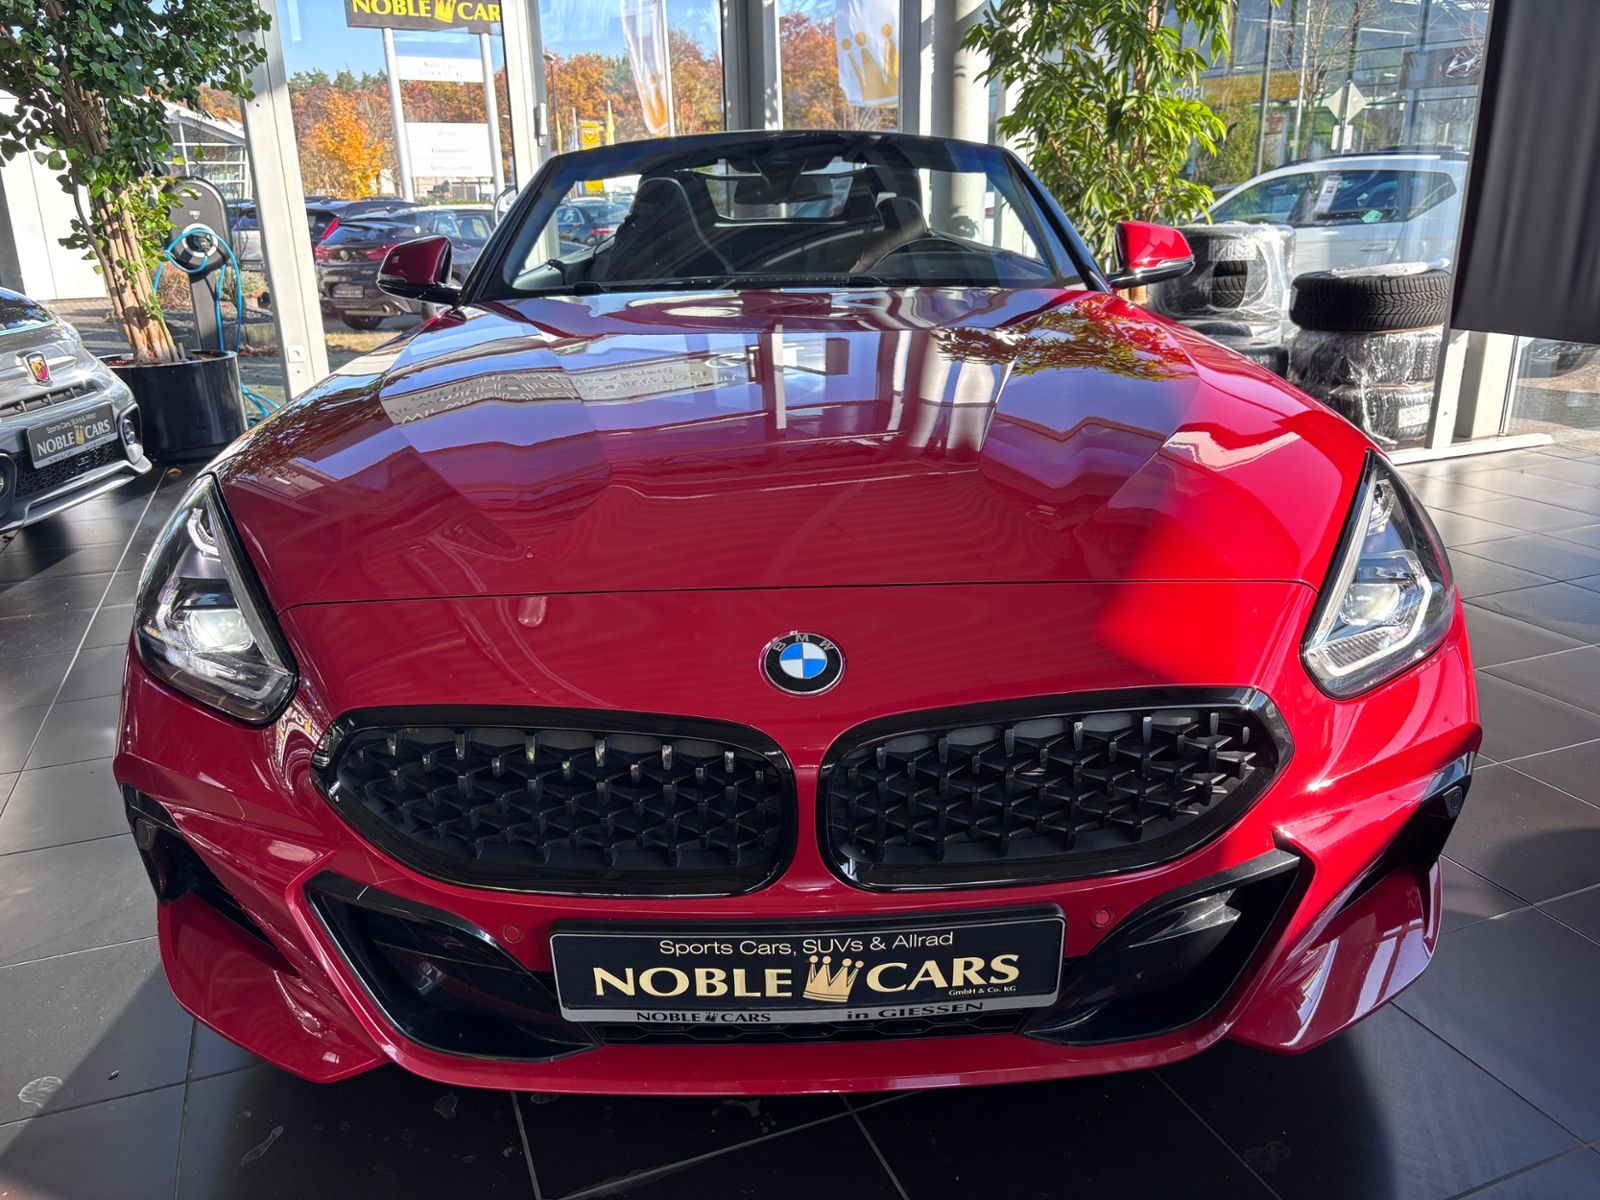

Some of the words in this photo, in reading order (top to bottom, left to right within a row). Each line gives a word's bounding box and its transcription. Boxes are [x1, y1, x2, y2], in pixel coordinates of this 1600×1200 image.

[353, 0, 432, 17] NOBLE
[457, 2, 501, 22] CAR
[1173, 85, 1206, 101] OPEL
[36, 431, 75, 457] NOBLE
[85, 419, 111, 439] CARS
[772, 634, 836, 652] BMW
[659, 940, 733, 957] Sports
[739, 940, 797, 957] Cars,
[802, 937, 864, 954] SUVs
[869, 936, 887, 951] &
[892, 931, 954, 949] Allrad
[593, 967, 792, 997] NOBLE
[866, 954, 1020, 993] CARS
[948, 988, 976, 997] GmbH
[987, 986, 1001, 994] Co.
[1003, 985, 1017, 993] KG
[636, 1012, 701, 1022] NOBLE
[721, 1012, 771, 1023] CARS
[848, 1011, 869, 1020] in
[878, 1002, 983, 1018] GIESSEN
